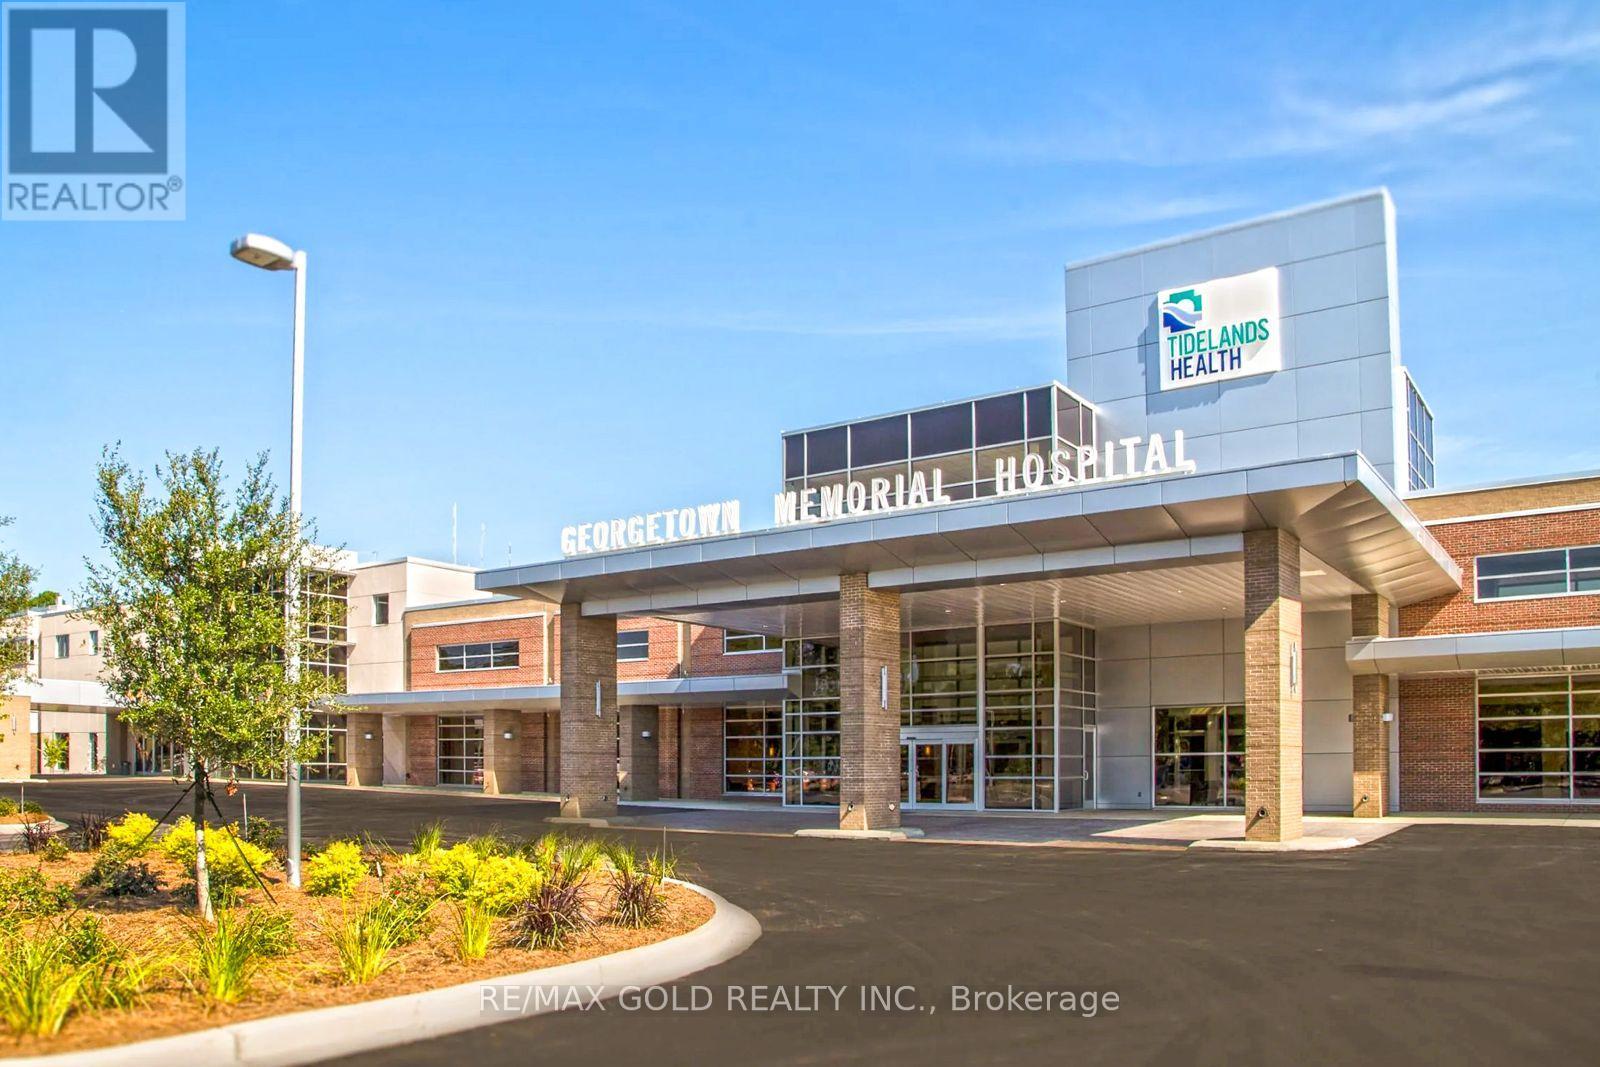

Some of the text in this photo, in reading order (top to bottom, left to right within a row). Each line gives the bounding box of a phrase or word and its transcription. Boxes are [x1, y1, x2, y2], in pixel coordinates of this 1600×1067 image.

[1167, 318, 1270, 358] TIDELANDS
[1171, 347, 1242, 381] HEALTH
[561, 430, 1196, 555] GEORGETOWN MEMORIAL HOSPITAL
